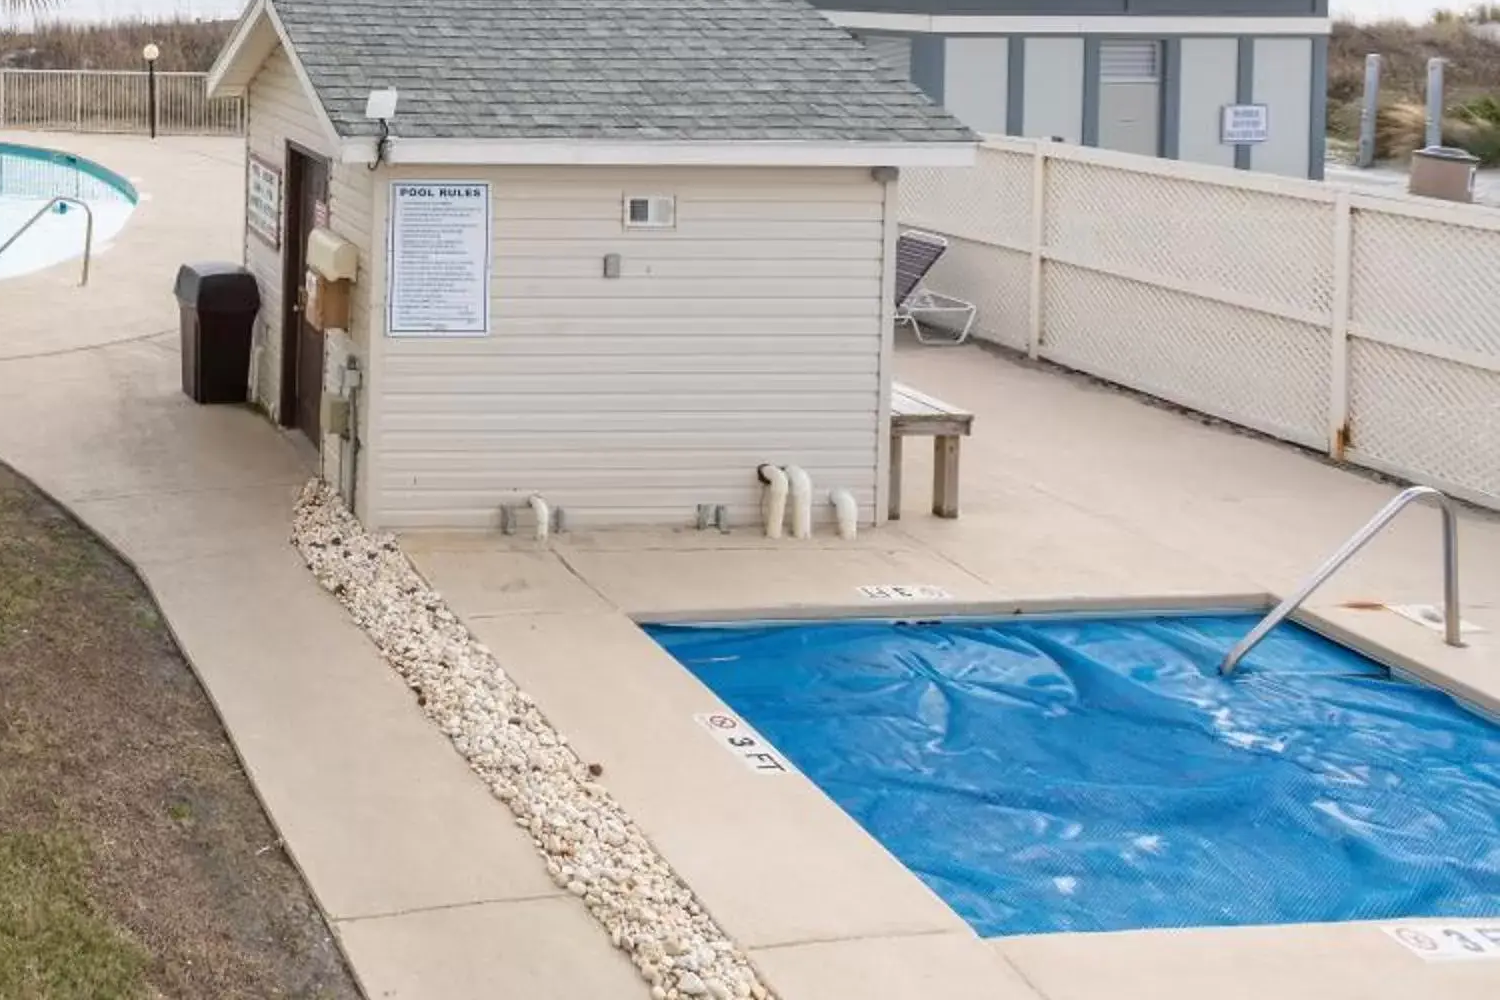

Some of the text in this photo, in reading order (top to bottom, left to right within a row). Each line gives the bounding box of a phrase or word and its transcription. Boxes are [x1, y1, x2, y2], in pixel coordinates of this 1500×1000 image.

[400, 187, 481, 197] POOL RULES
[727, 736, 787, 772] 3 FT
[1442, 928, 1486, 953] 3
